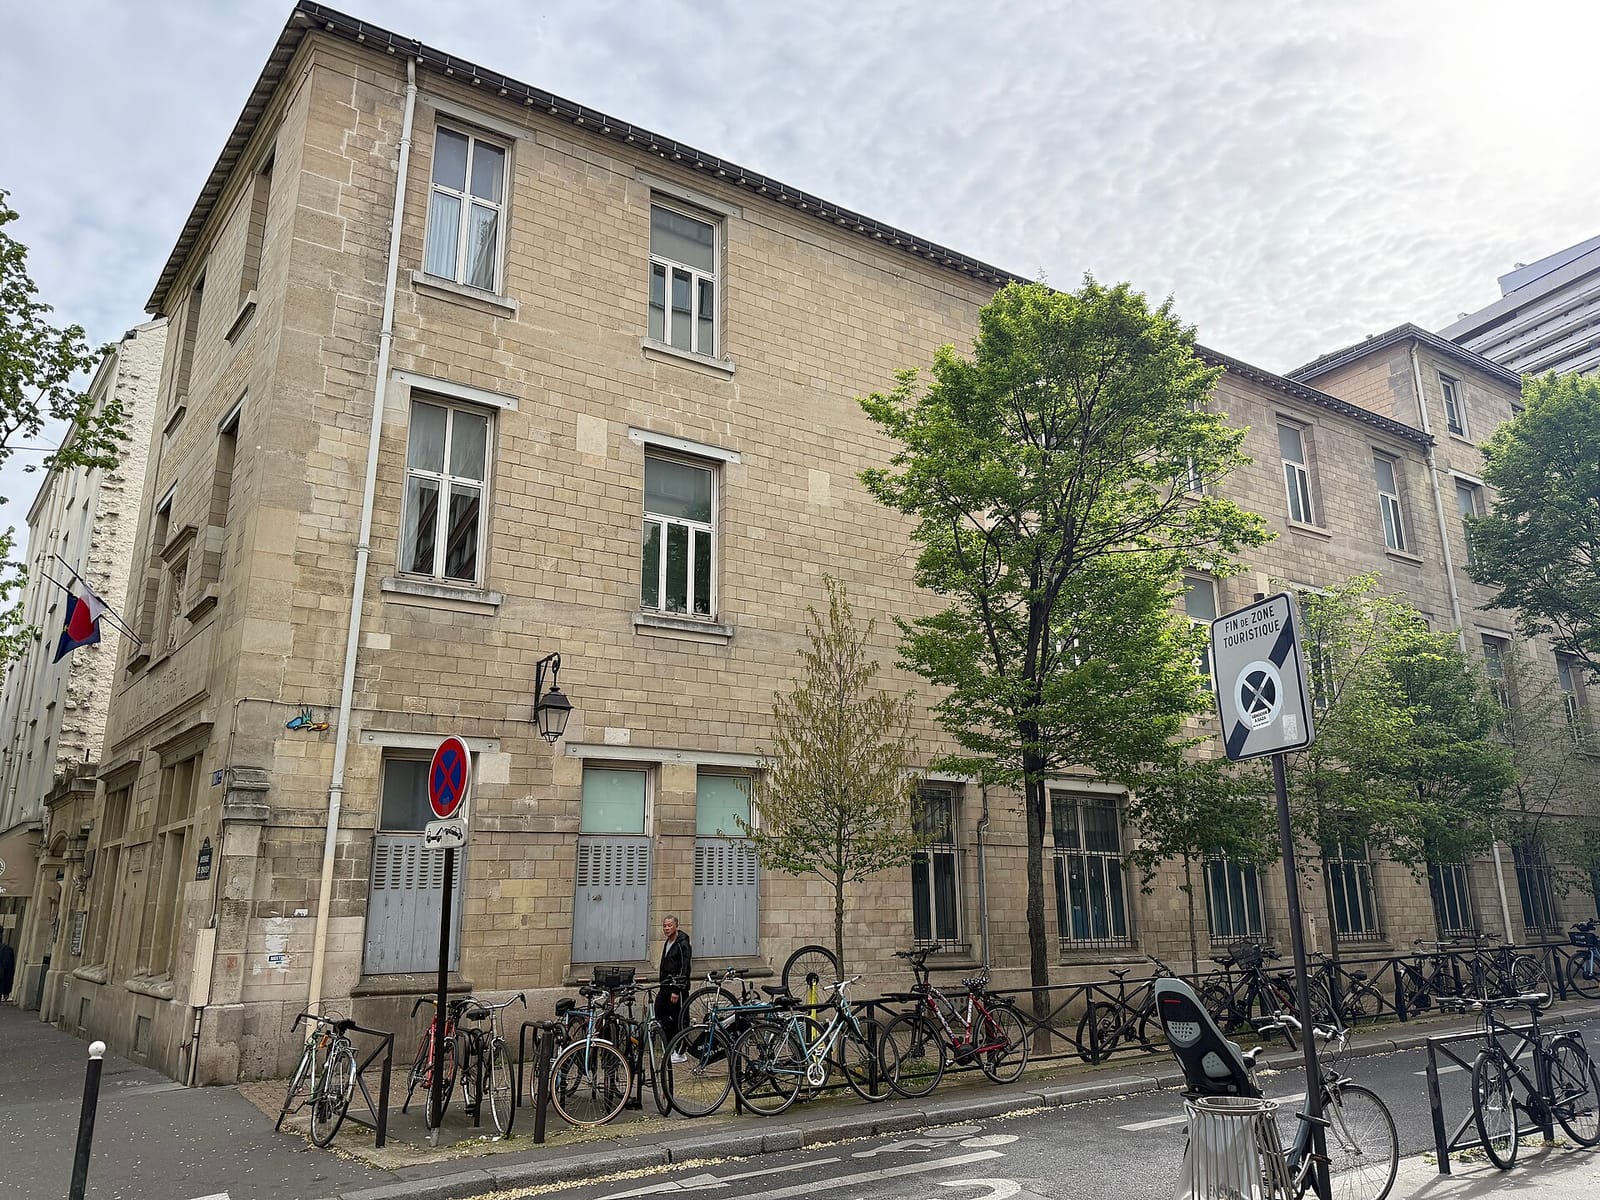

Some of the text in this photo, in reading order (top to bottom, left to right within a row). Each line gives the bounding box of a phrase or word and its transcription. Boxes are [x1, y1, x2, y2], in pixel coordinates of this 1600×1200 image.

[1225, 605, 1275, 633] FIN DE ZONE
[1223, 619, 1280, 649] TOURISTIQUE
